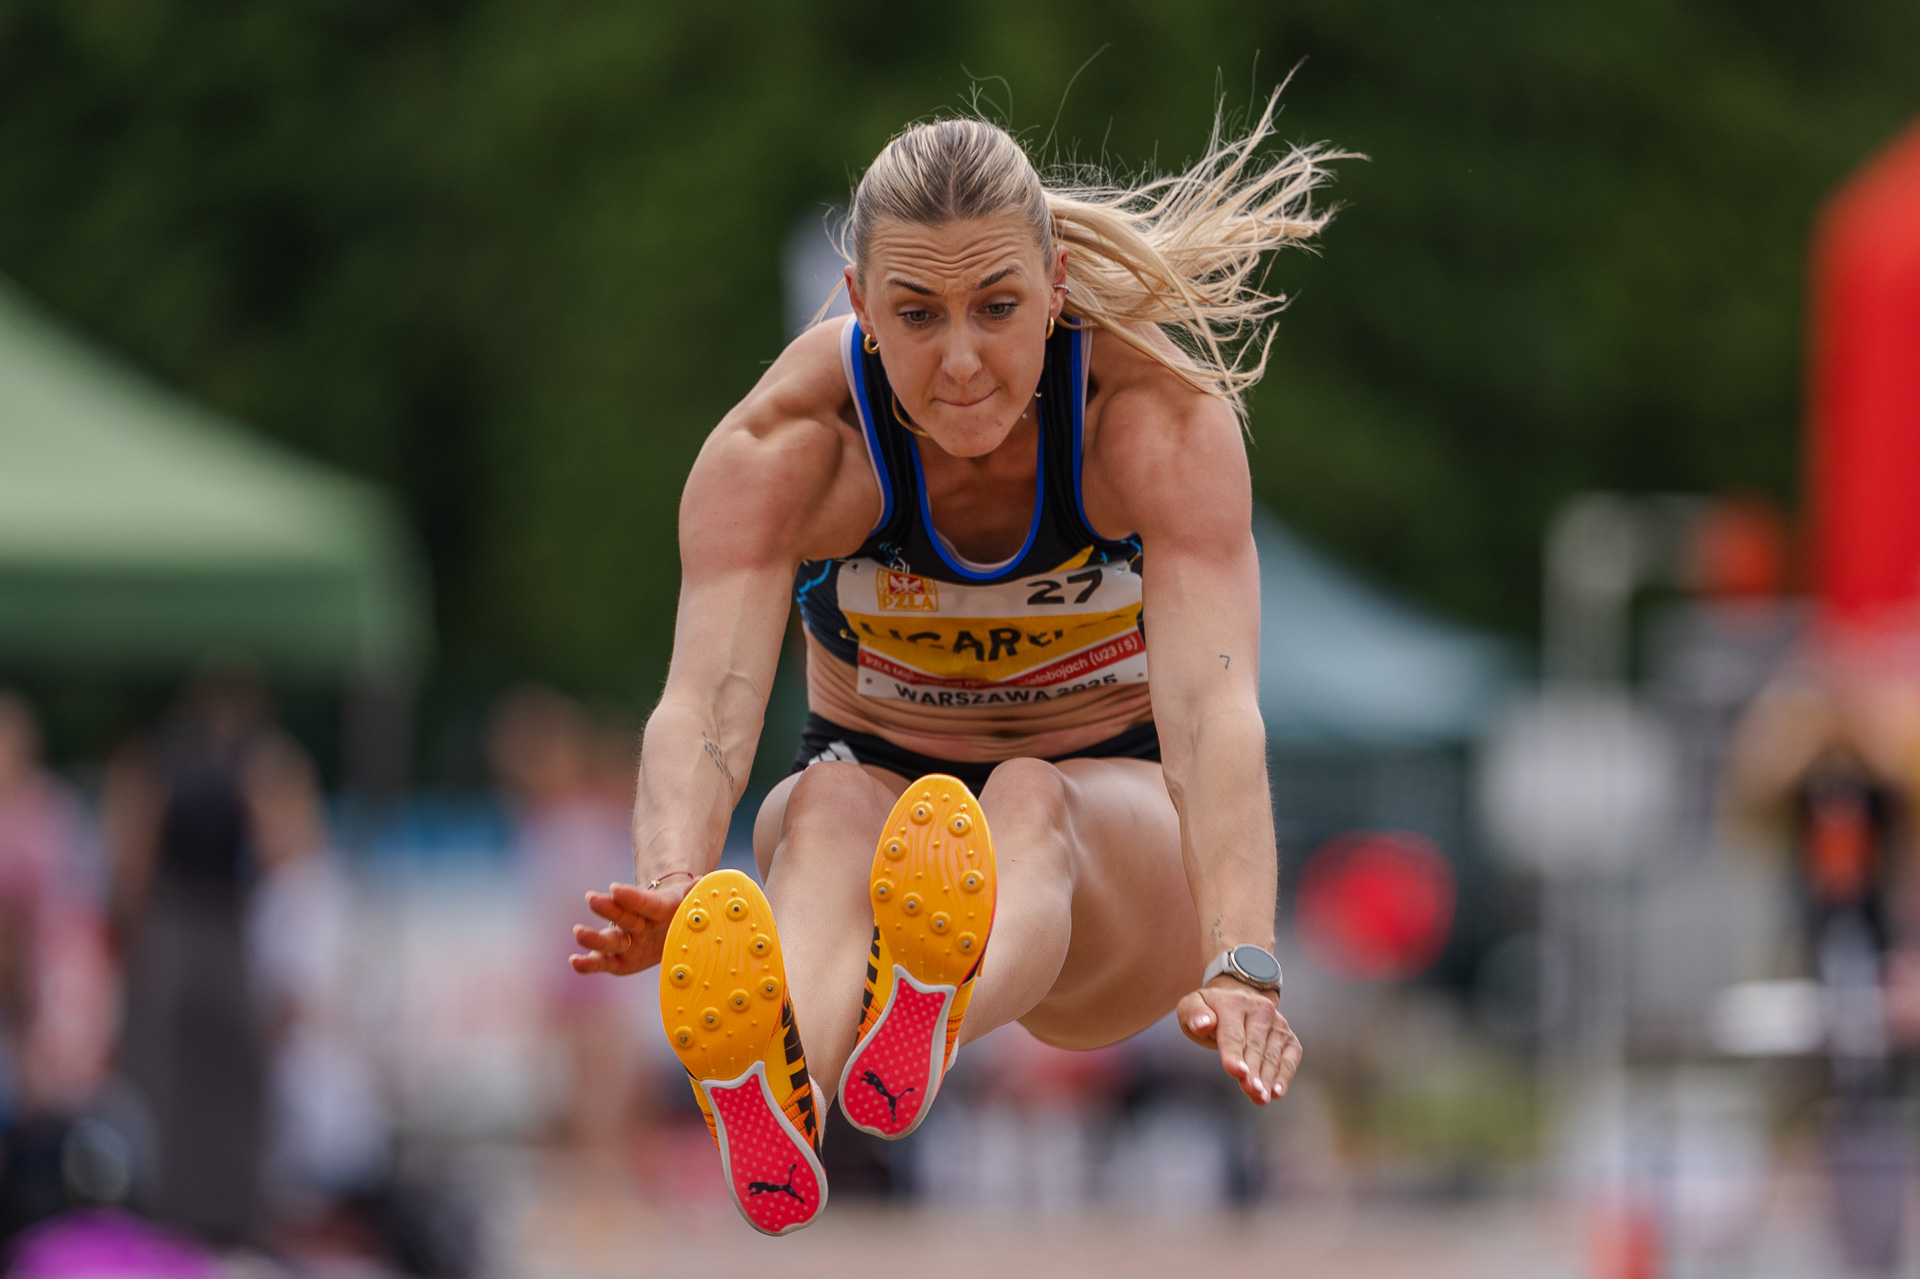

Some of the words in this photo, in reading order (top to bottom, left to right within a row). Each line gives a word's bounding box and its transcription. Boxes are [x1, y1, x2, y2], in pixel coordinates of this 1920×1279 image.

[1027, 569, 1104, 606] 27
[880, 594, 936, 610] PZLA
[894, 683, 1051, 707] WARSZAWA
